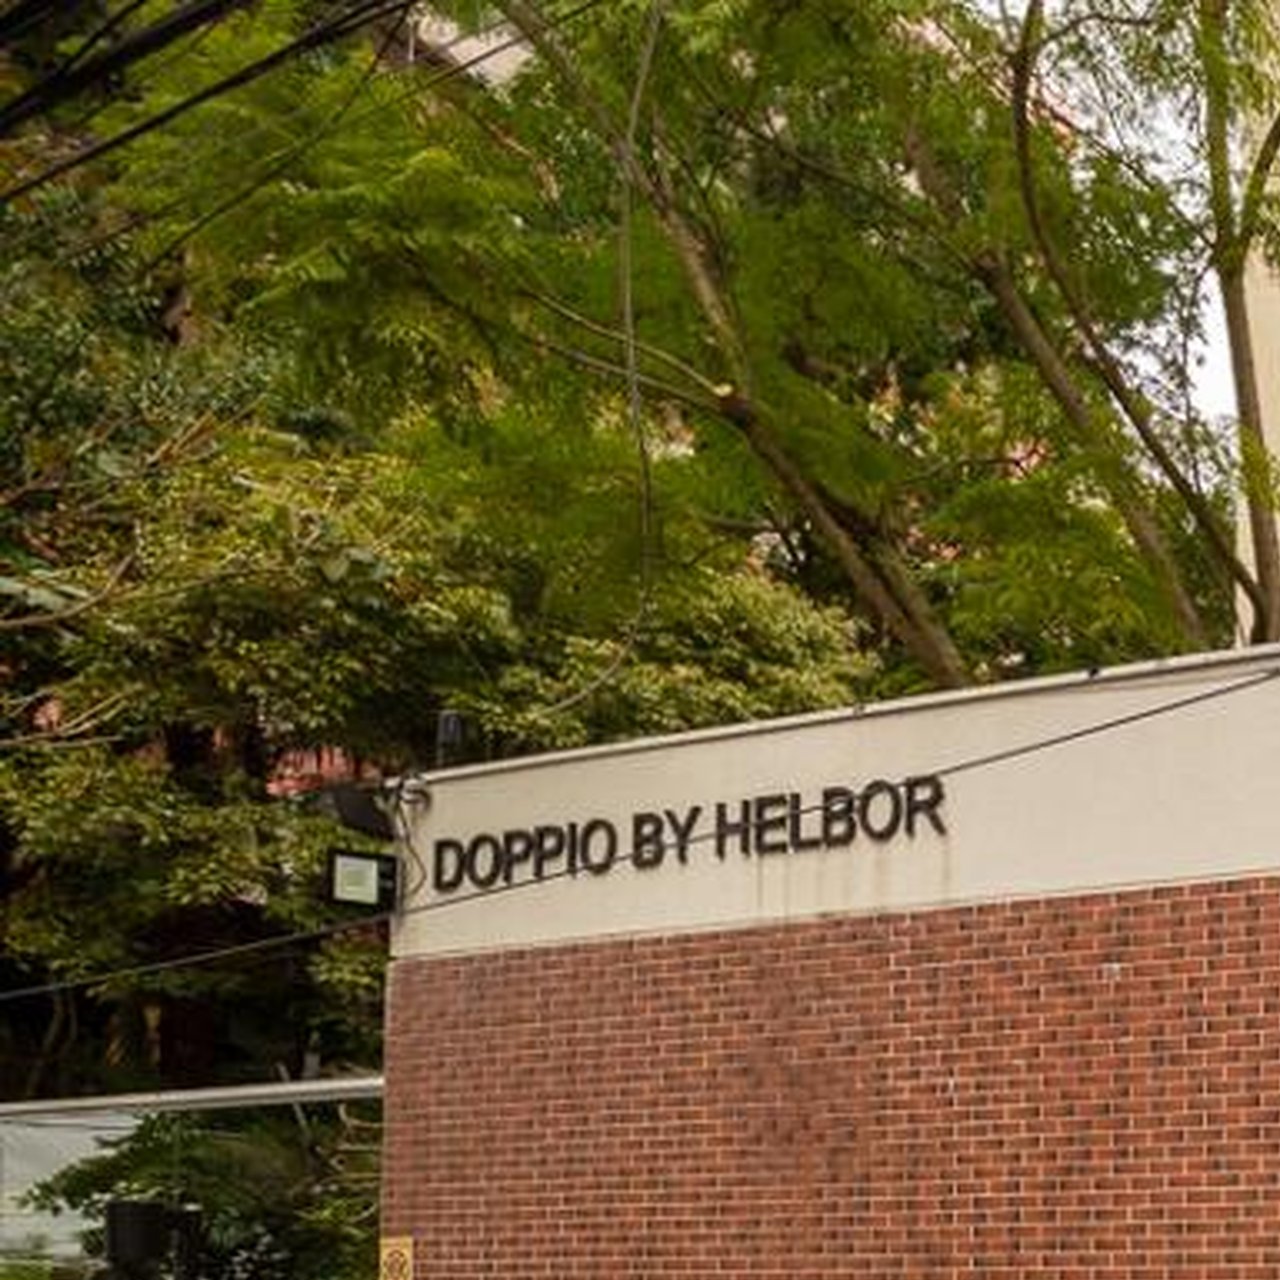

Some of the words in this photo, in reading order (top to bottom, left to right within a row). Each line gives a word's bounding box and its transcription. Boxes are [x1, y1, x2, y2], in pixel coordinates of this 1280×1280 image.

[432, 819, 617, 893] DOPPIO
[632, 806, 701, 870] BY
[714, 774, 947, 860] HELBOR
